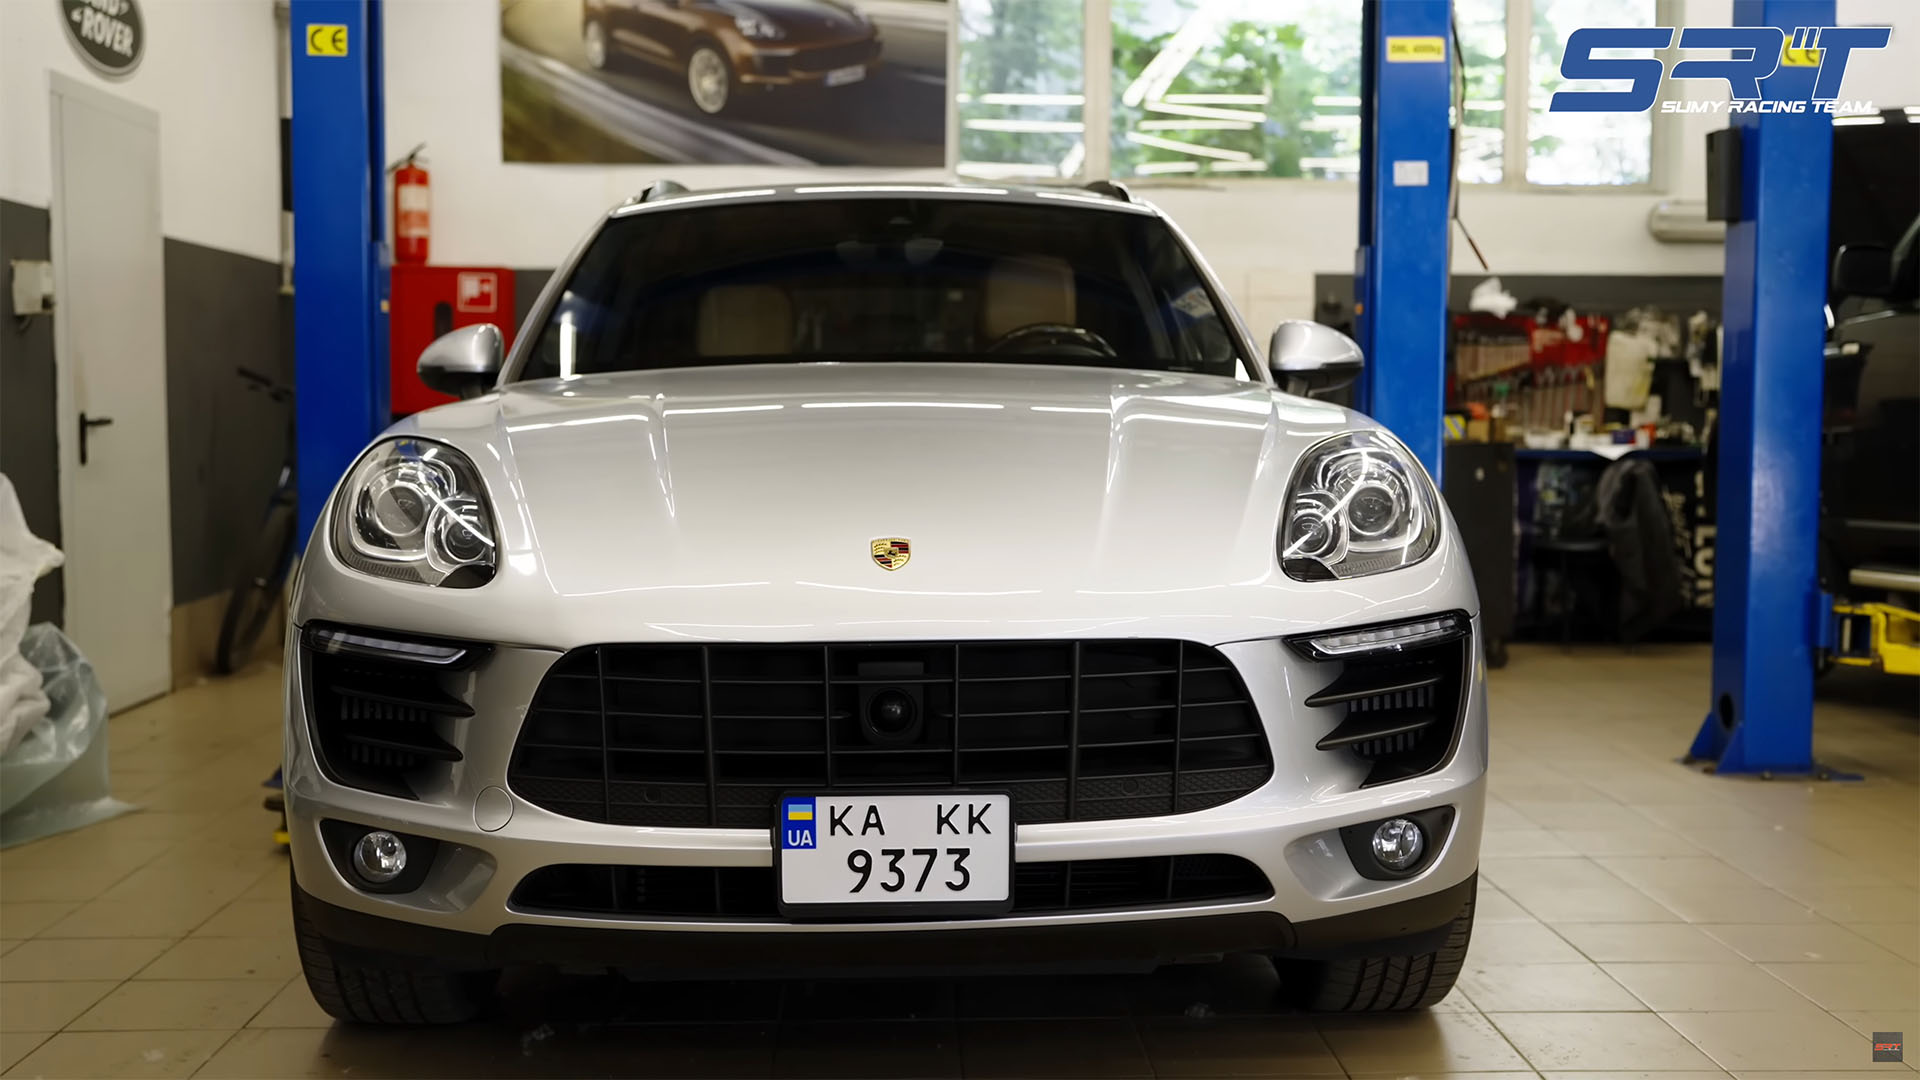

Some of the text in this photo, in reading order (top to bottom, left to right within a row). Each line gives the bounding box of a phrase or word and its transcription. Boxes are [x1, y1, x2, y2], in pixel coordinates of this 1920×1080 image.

[81, 6, 134, 58] ROVER
[788, 829, 813, 846] UA
[829, 803, 992, 836] KA KK
[847, 848, 971, 893] 9373
